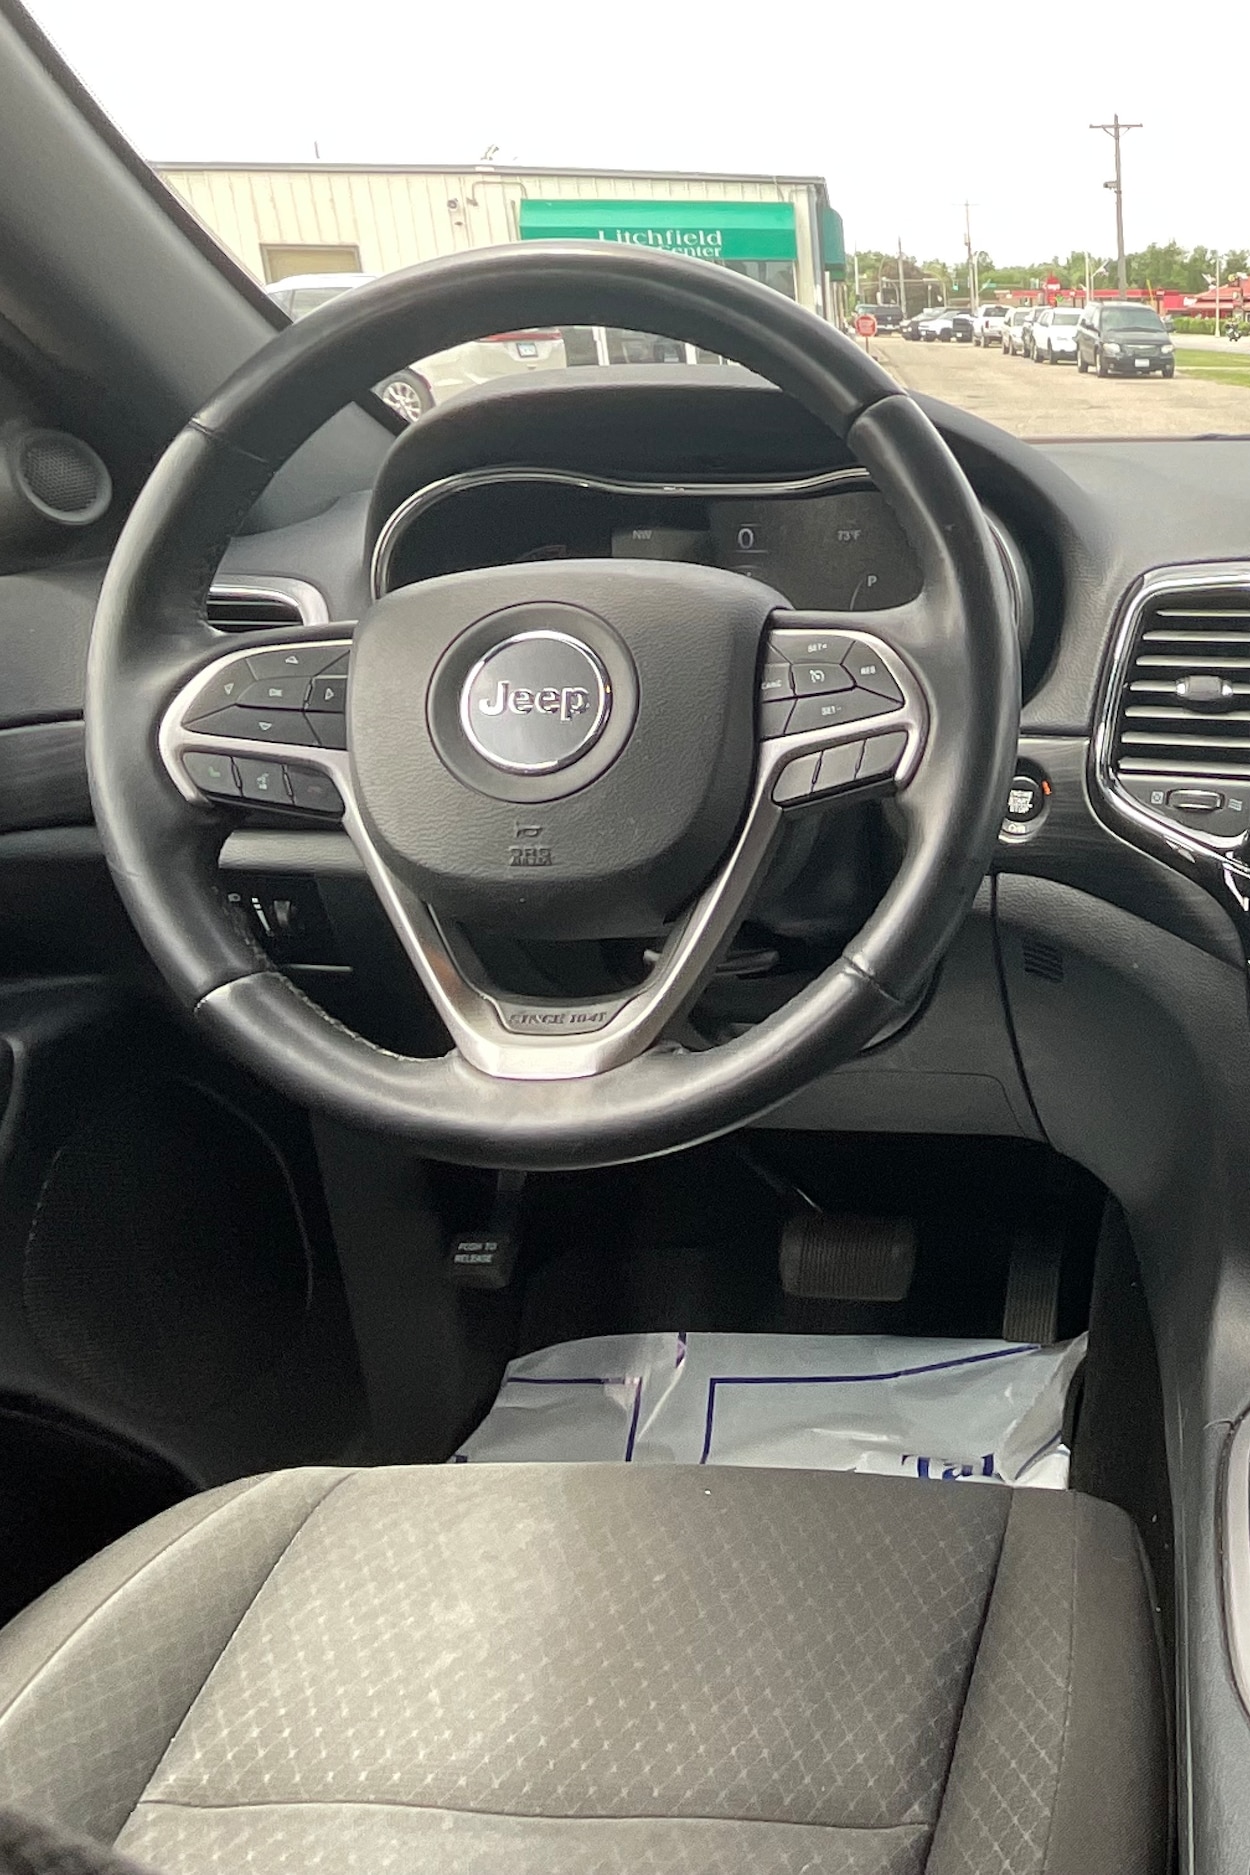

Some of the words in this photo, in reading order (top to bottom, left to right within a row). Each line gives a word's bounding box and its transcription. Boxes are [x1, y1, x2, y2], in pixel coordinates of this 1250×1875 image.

[598, 229, 722, 247] Litchfield
[737, 528, 754, 549] 0
[867, 575, 878, 587] P
[478, 680, 590, 723] Jeep
[509, 1014, 566, 1024] SINCE
